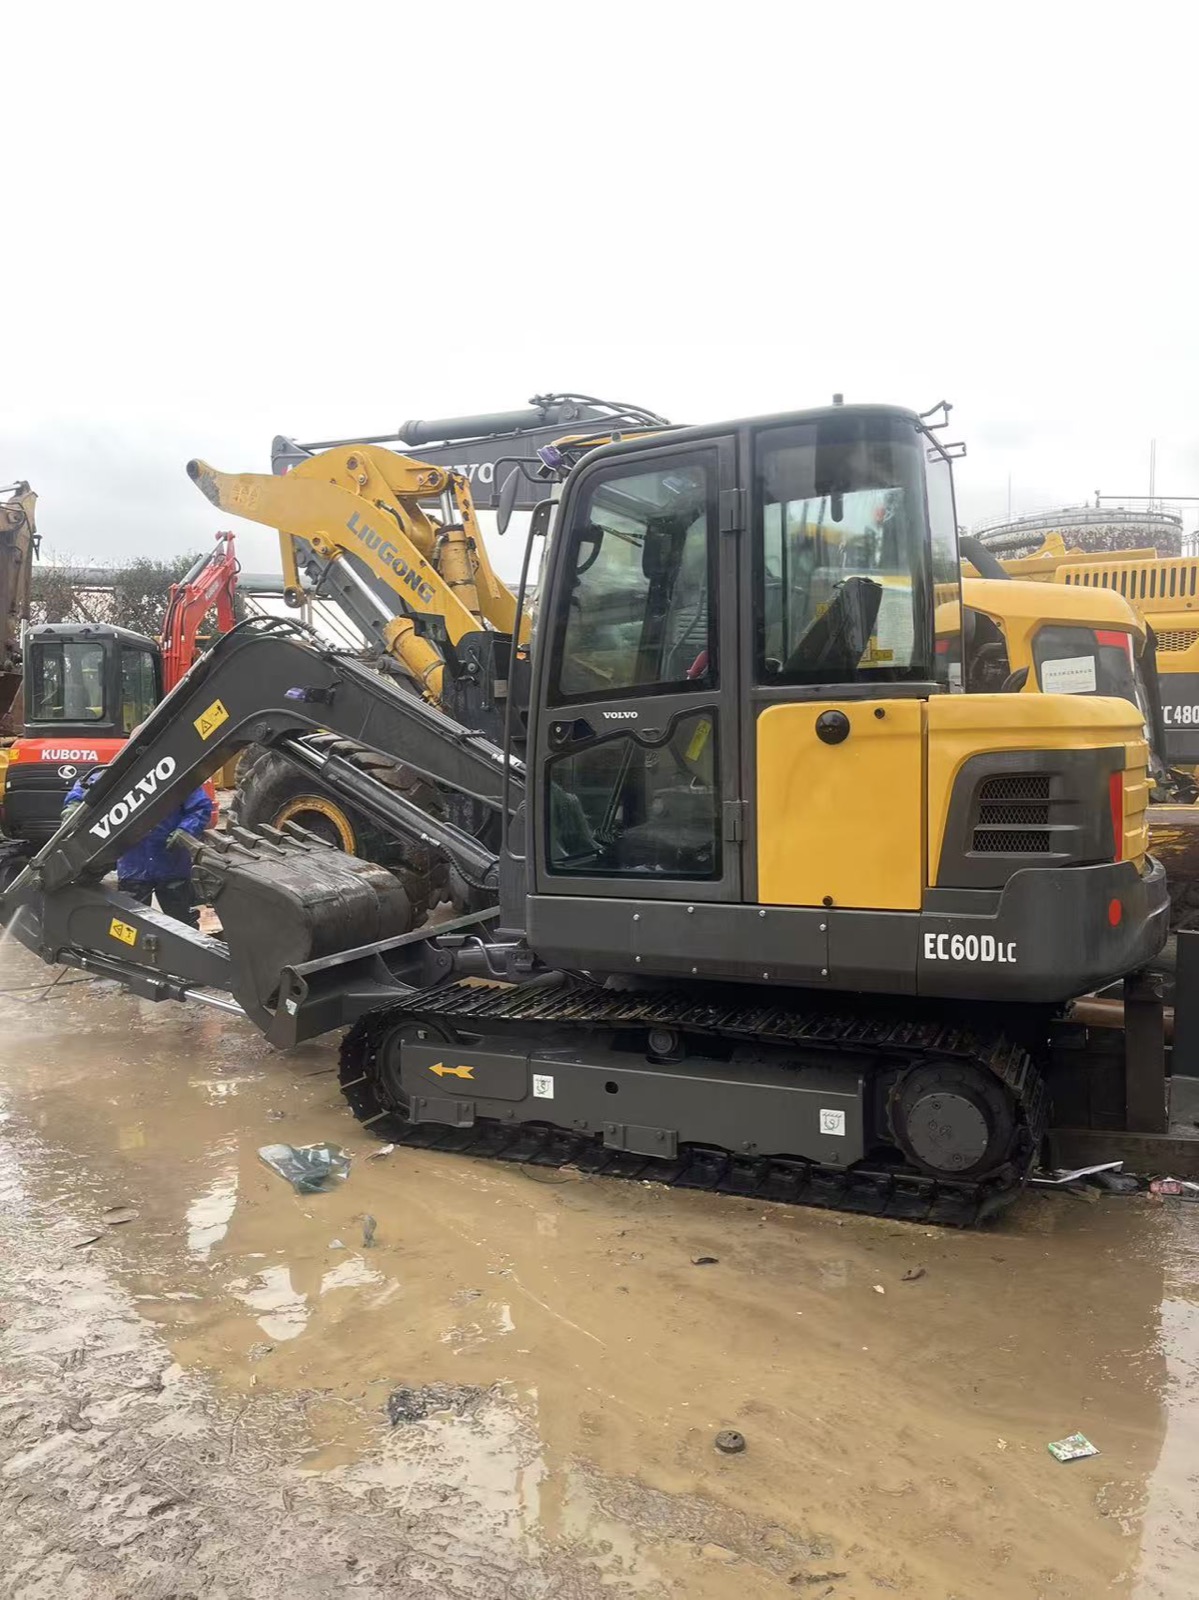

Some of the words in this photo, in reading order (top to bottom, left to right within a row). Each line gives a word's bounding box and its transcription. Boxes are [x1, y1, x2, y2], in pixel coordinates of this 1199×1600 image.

[602, 711, 638, 719] VOLVO
[1161, 705, 1199, 724] C480
[41, 749, 99, 761] KUBOTA
[89, 756, 176, 839] VOLVO
